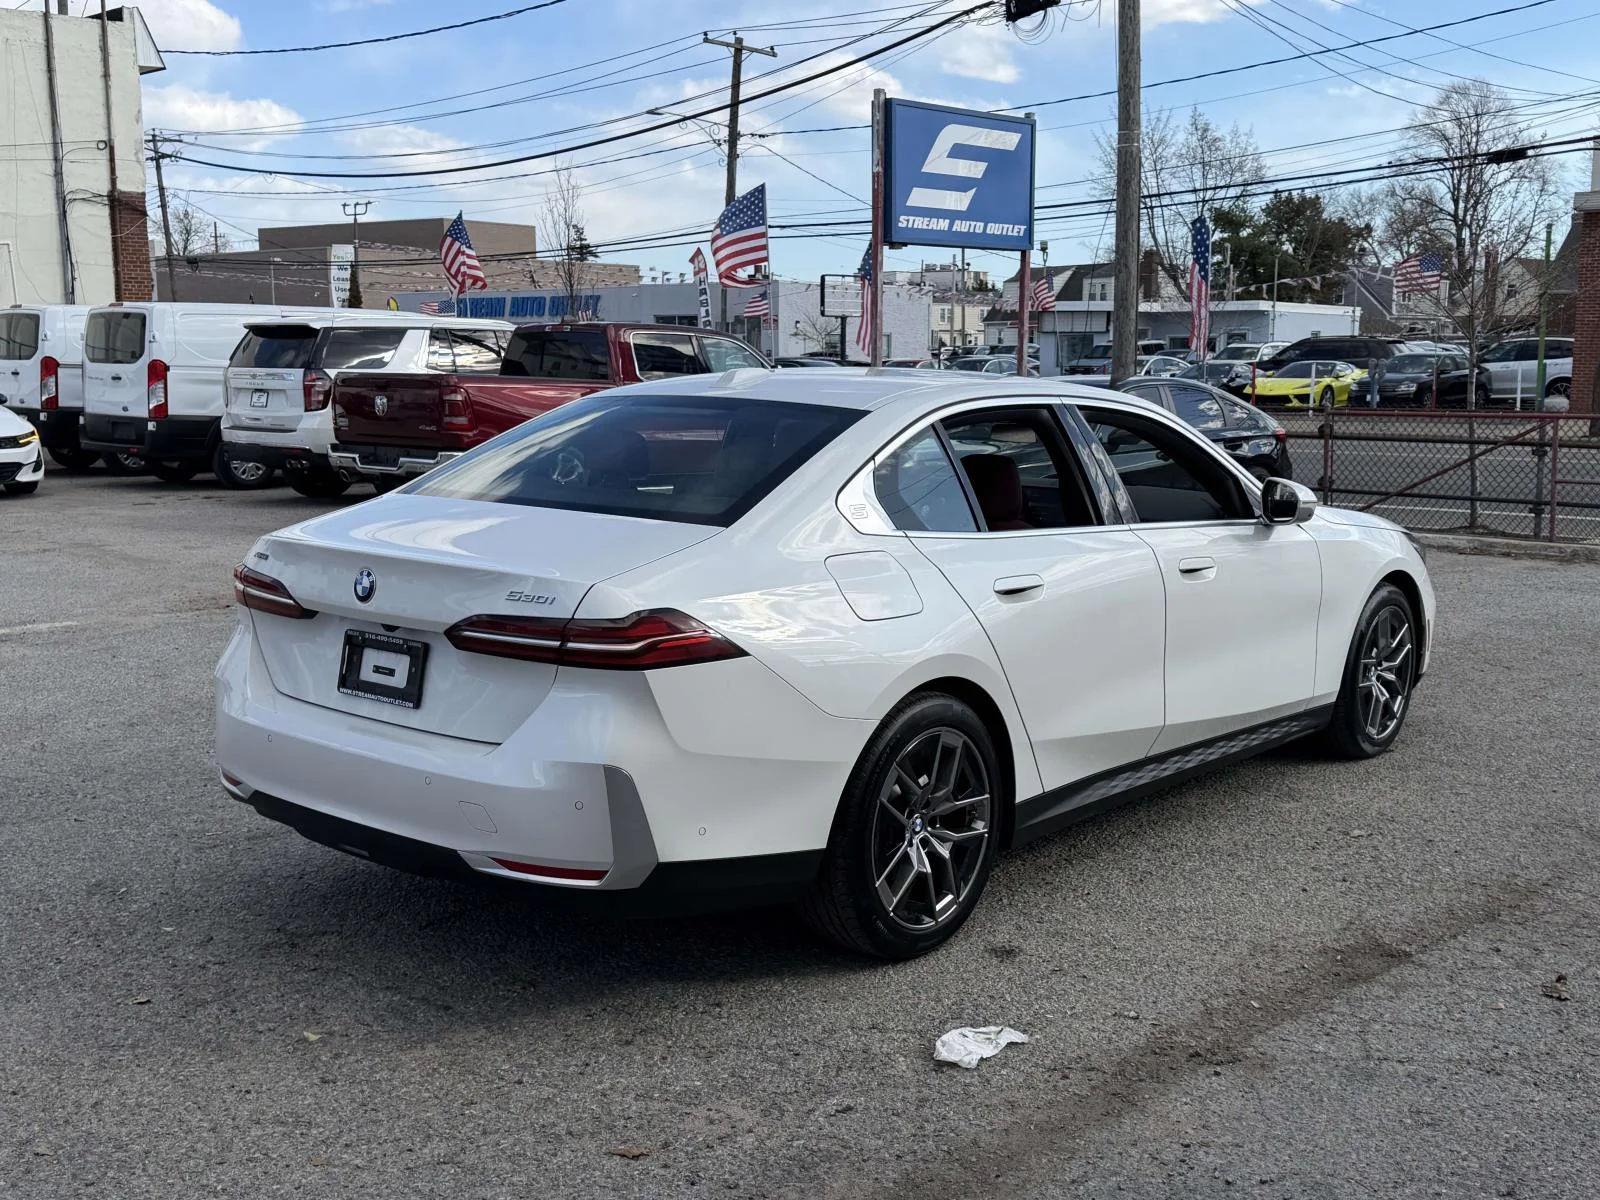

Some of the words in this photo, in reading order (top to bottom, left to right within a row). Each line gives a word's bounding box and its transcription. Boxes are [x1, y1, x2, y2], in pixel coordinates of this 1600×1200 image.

[898, 215, 950, 231] STREAM
[952, 219, 984, 234] AUTO
[986, 222, 1027, 237] OUTLET
[509, 296, 547, 317] AUTO
[504, 590, 556, 605] 530i
